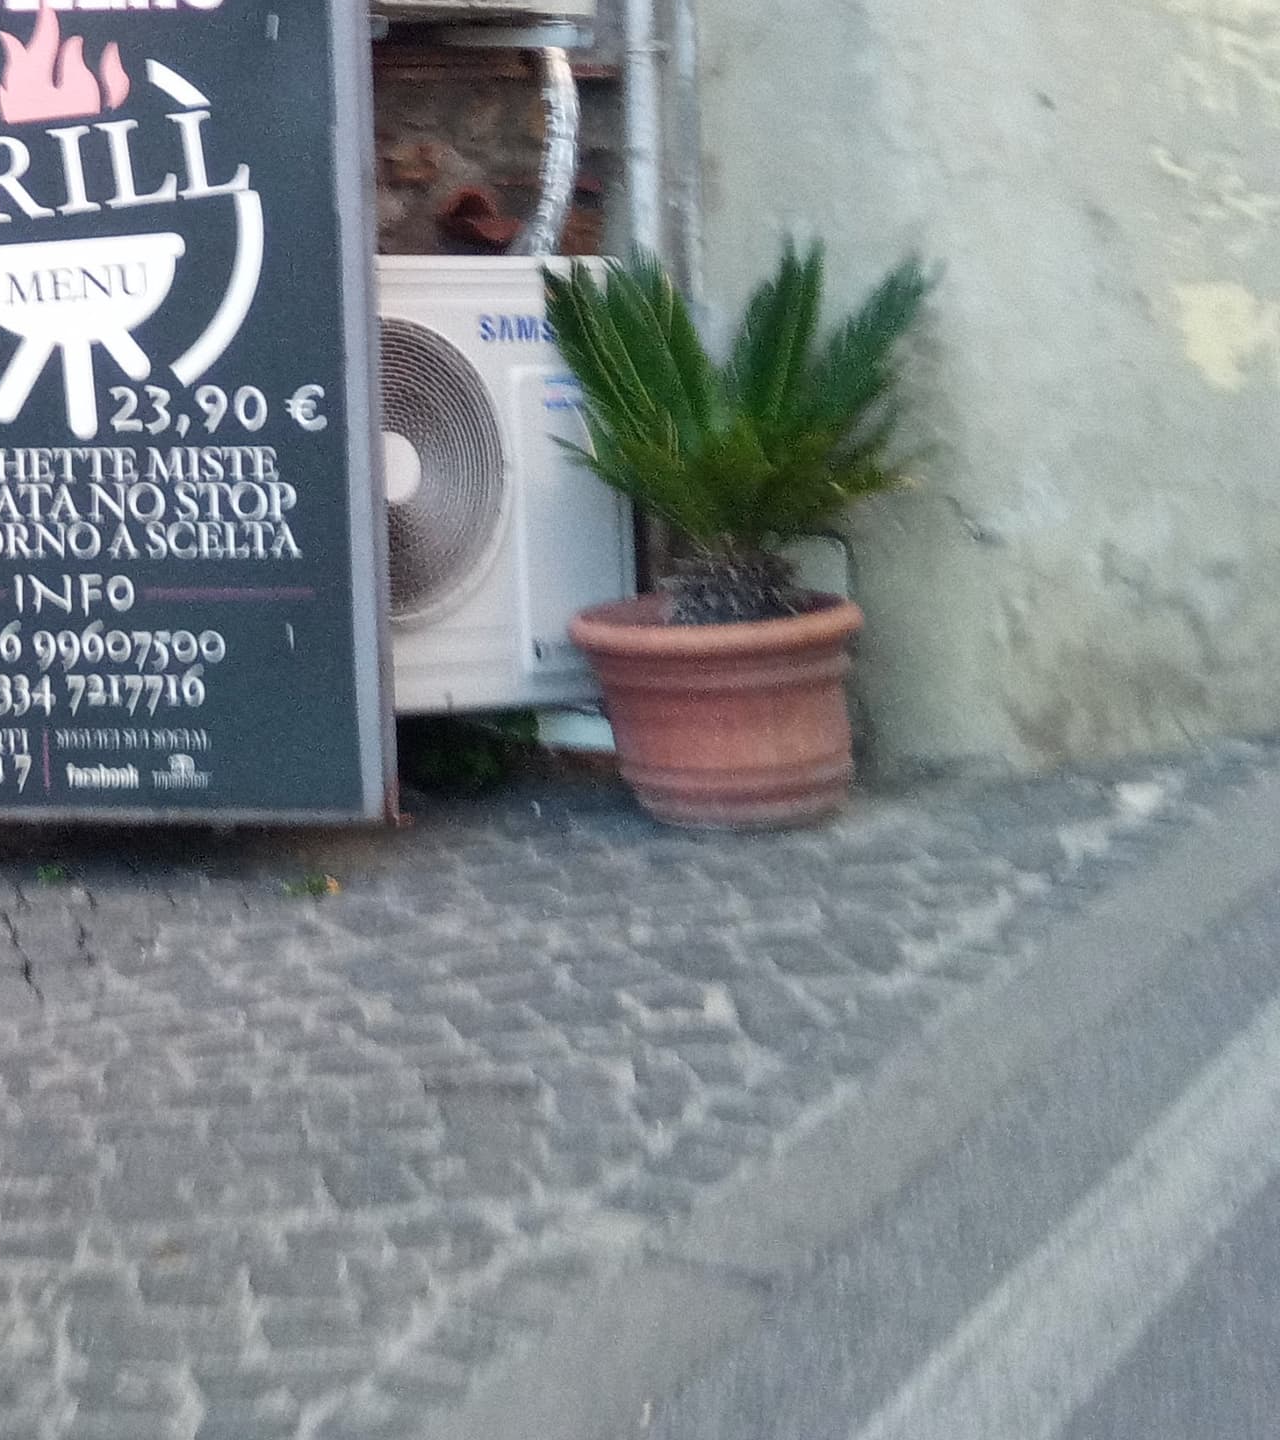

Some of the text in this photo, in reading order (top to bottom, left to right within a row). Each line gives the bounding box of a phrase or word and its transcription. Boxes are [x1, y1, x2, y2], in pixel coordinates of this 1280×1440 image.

[7, 262, 148, 306] MENU
[111, 384, 327, 438] 23,90 €
[145, 447, 279, 482] MISTE
[88, 483, 166, 520] NO
[174, 483, 297, 521] STOP
[109, 524, 139, 559] A
[145, 522, 301, 559] SCELTA
[13, 574, 136, 615] INFO
[14, 754, 31, 793] 7
